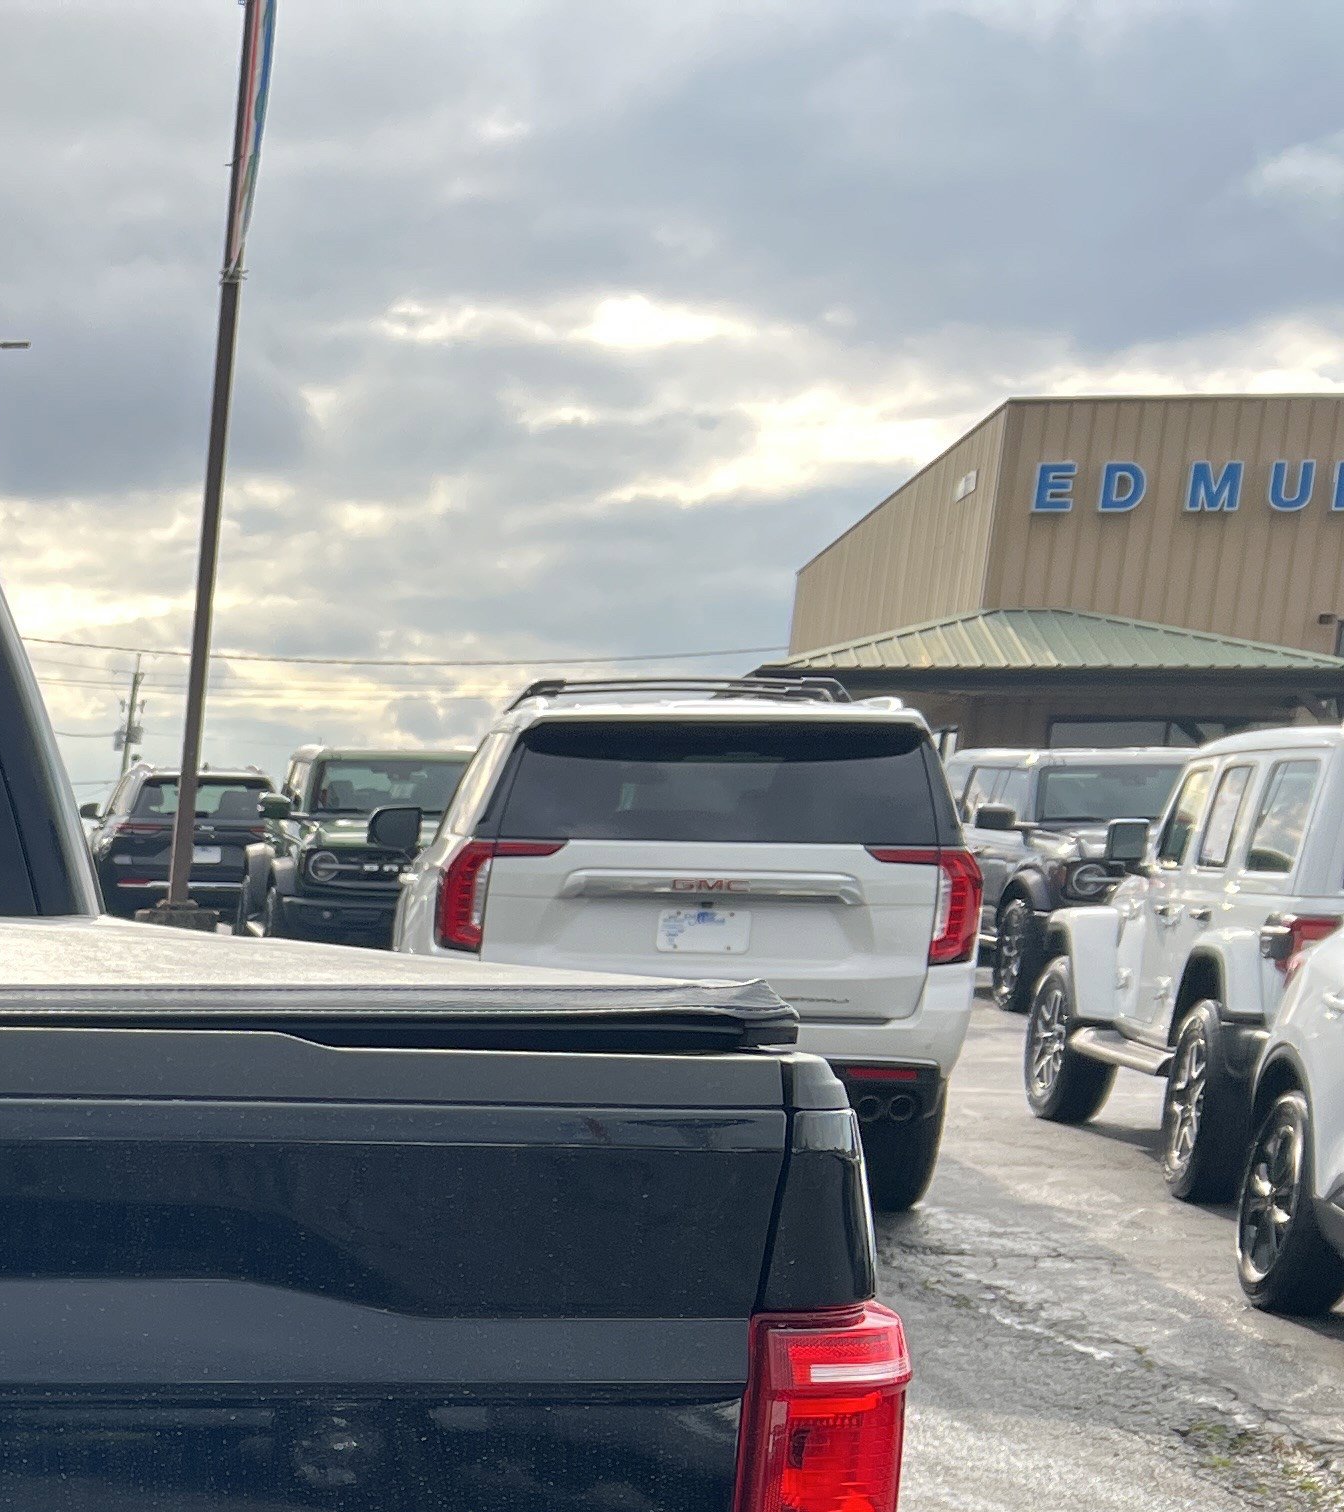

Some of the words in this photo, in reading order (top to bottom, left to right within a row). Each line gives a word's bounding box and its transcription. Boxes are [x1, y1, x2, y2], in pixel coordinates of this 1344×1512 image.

[1031, 459, 1148, 513] ED
[1184, 459, 1344, 513] MU
[672, 879, 751, 893] GMC
